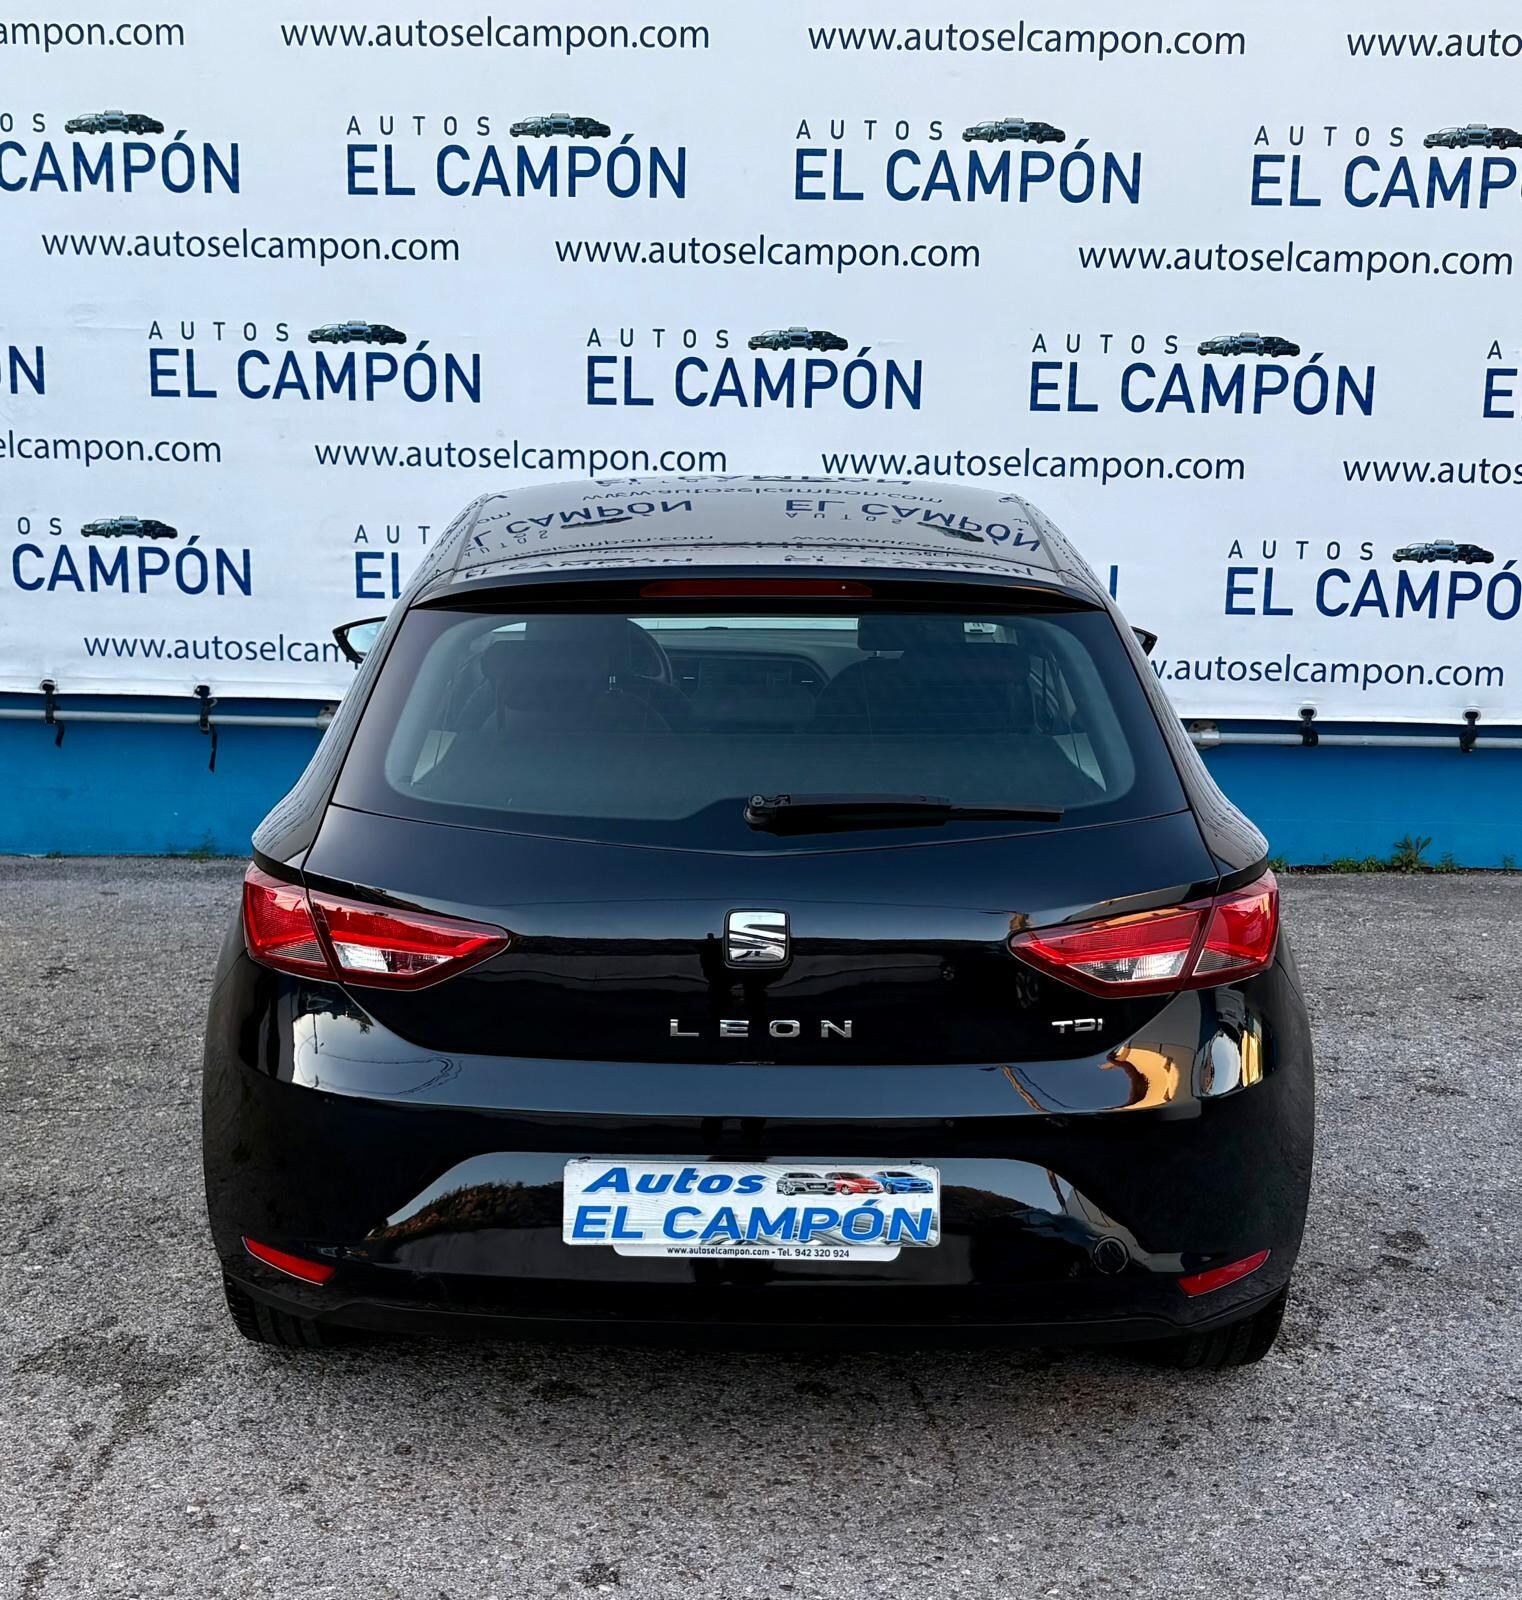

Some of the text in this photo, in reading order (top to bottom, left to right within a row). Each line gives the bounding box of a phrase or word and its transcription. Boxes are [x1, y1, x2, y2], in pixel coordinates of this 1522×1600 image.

[281, 16, 708, 55] www.autoselcampon.com
[808, 20, 1245, 61] www.autoselcampon.com
[347, 116, 490, 136] AUTOS
[796, 119, 942, 140] AUTOS
[1254, 126, 1403, 147] AUTOS
[0, 130, 240, 194] CAMPÓN
[347, 134, 686, 198] EL CAMPÓN
[795, 138, 1141, 204] EL CAMPÓN
[1251, 154, 1522, 209] EL CAMP
[42, 228, 459, 263] www.autoselcampon.com
[555, 234, 979, 274] www.autoselcampon.com
[1079, 241, 1512, 281] www.autoselcampon.com
[149, 321, 288, 342] AUTOS
[587, 328, 728, 348] AUTOS
[1032, 333, 1177, 354] AUTOS
[150, 340, 480, 403] EL CAMPÓN
[587, 346, 922, 410] EL CAMPÓN
[1030, 352, 1375, 416] EL CAMPÓN
[315, 440, 726, 476] www.autoselcampon.com
[822, 448, 1244, 484] www.autoselcampon.com
[18, 517, 62, 536] OS
[12, 536, 251, 596] CAMPÓN
[1228, 540, 1373, 560] AUTOS
[1225, 559, 1522, 620] EL CAMPÓ
[670, 1019, 852, 1038] LEON
[1051, 1018, 1103, 1034] TDI
[581, 1166, 768, 1195] Autos
[571, 1199, 933, 1242] EL CAMPÓN
[667, 1247, 770, 1257] www.autoselcampon.com
[777, 1247, 793, 1257] Tel.
[794, 1248, 812, 1258] 942
[813, 1248, 831, 1258] 320
[833, 1248, 850, 1258] 924
